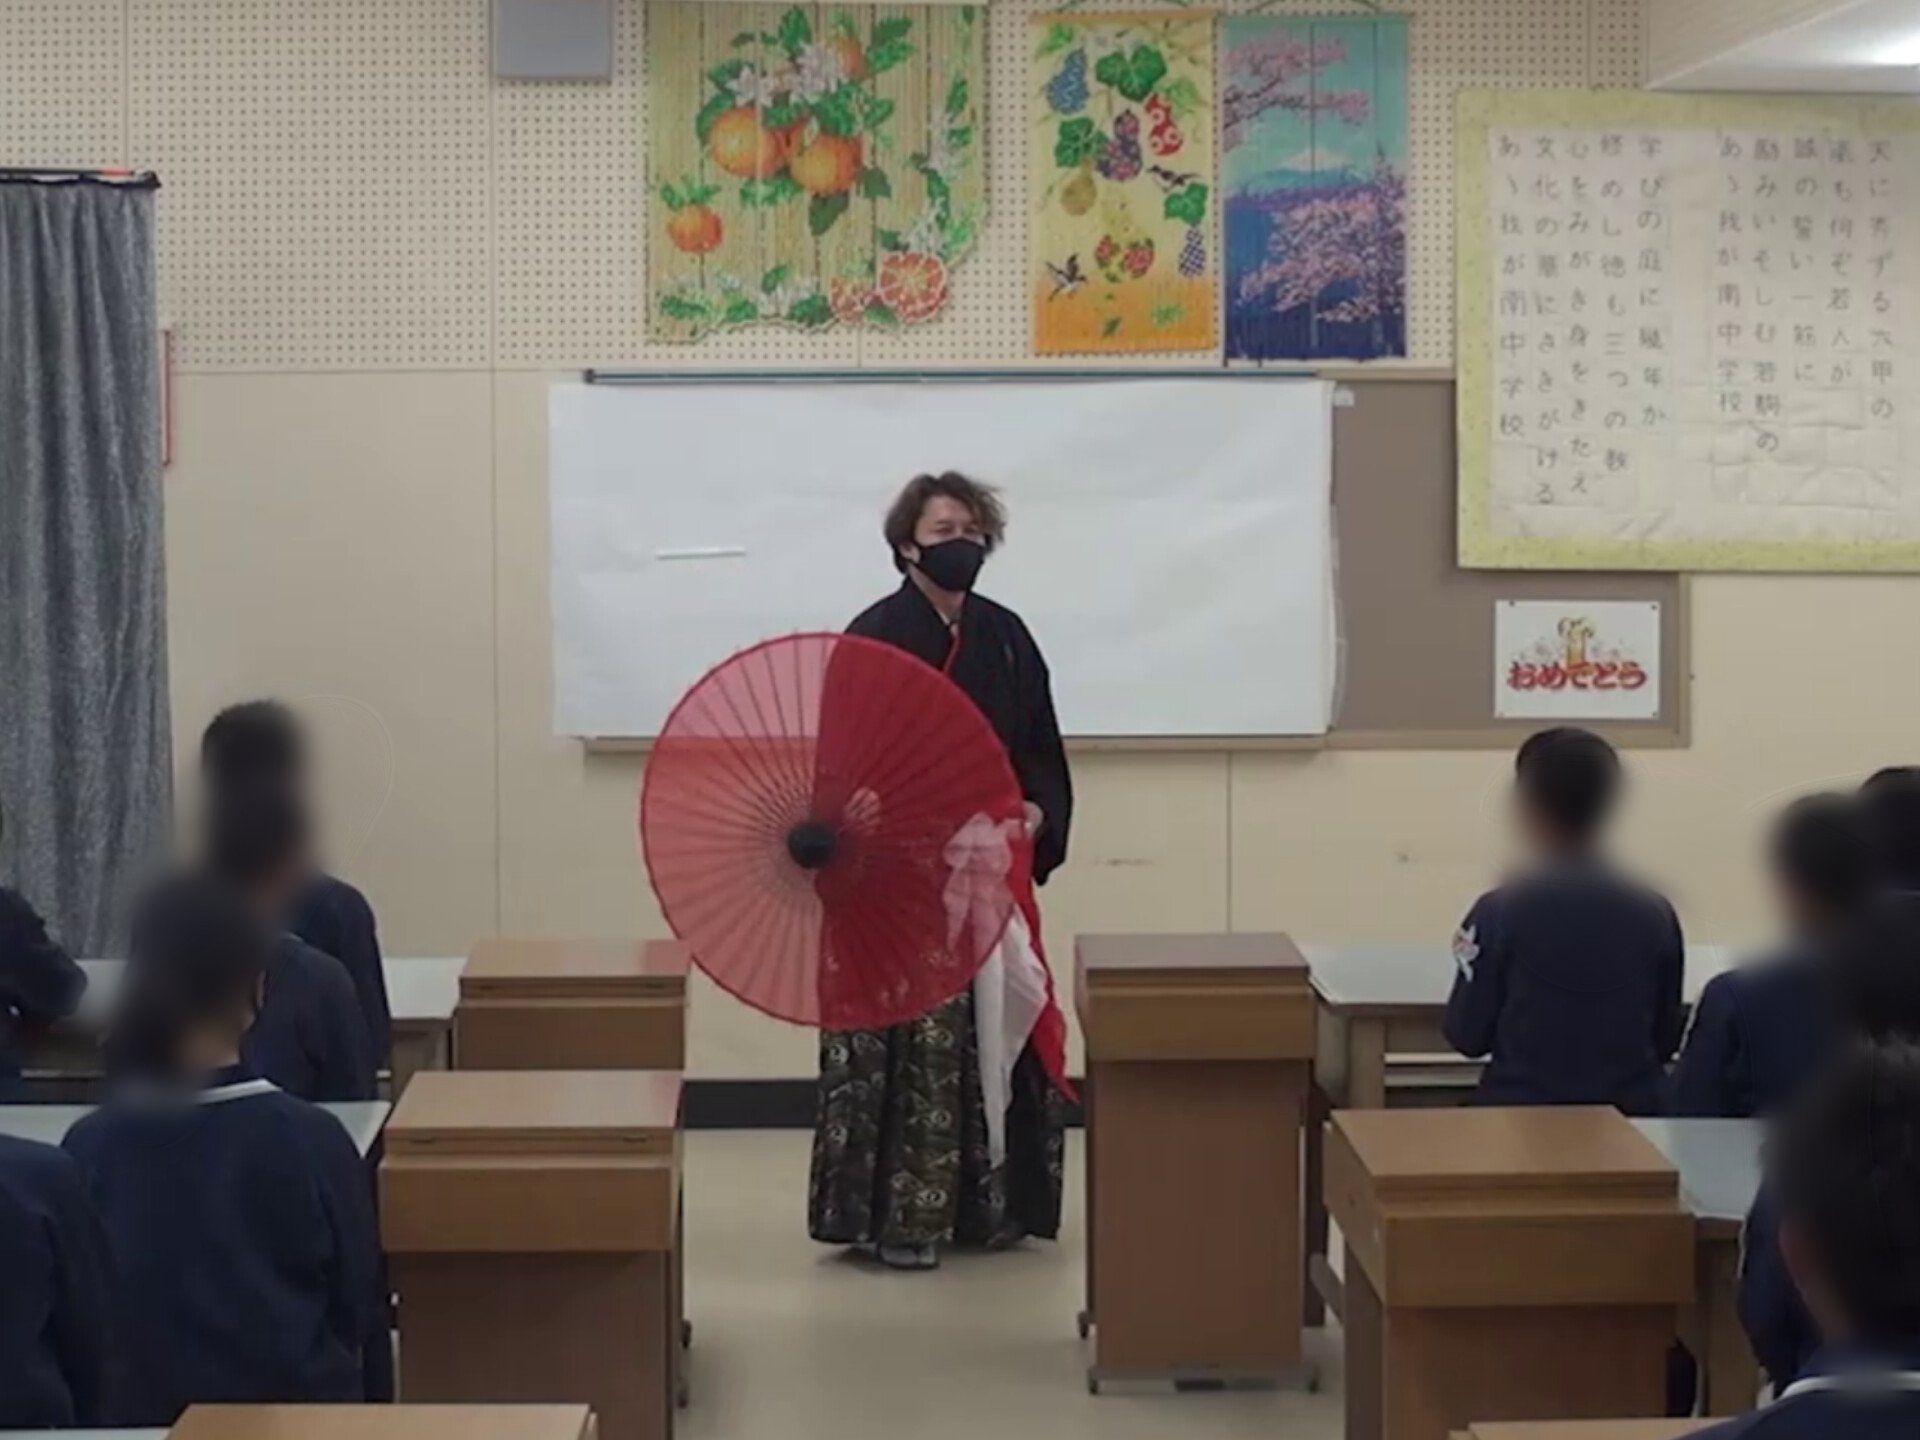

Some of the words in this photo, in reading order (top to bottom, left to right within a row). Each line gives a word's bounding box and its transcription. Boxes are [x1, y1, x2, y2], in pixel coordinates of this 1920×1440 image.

[1507, 660, 1648, 691] おめでとう
